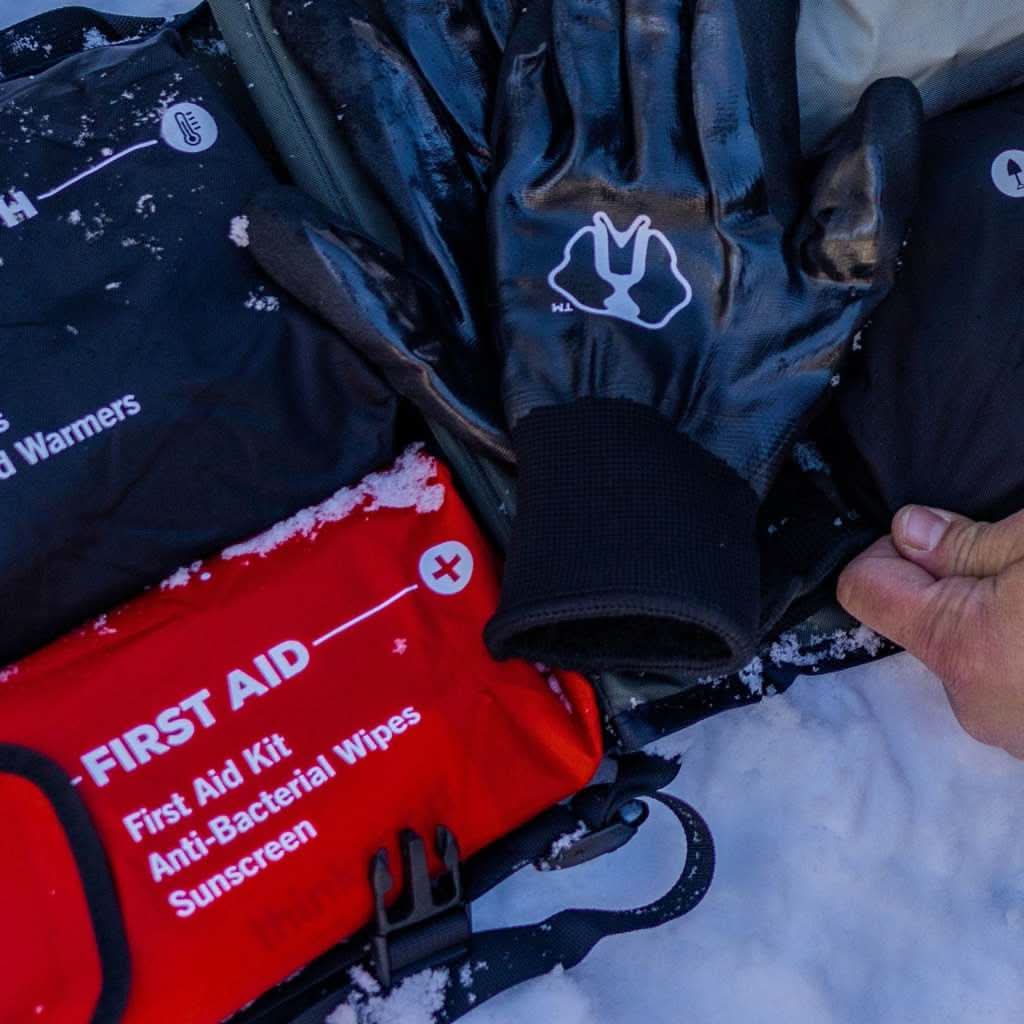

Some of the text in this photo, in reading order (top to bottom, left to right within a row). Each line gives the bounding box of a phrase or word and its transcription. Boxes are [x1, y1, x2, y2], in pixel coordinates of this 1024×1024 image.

[13, 394, 141, 465] Warmers
[82, 640, 310, 787] FIRST AID
[122, 733, 293, 842] First Aid Kit
[149, 706, 421, 882] Anti-Bacterial Wipes
[168, 820, 318, 917] Sunscreen
